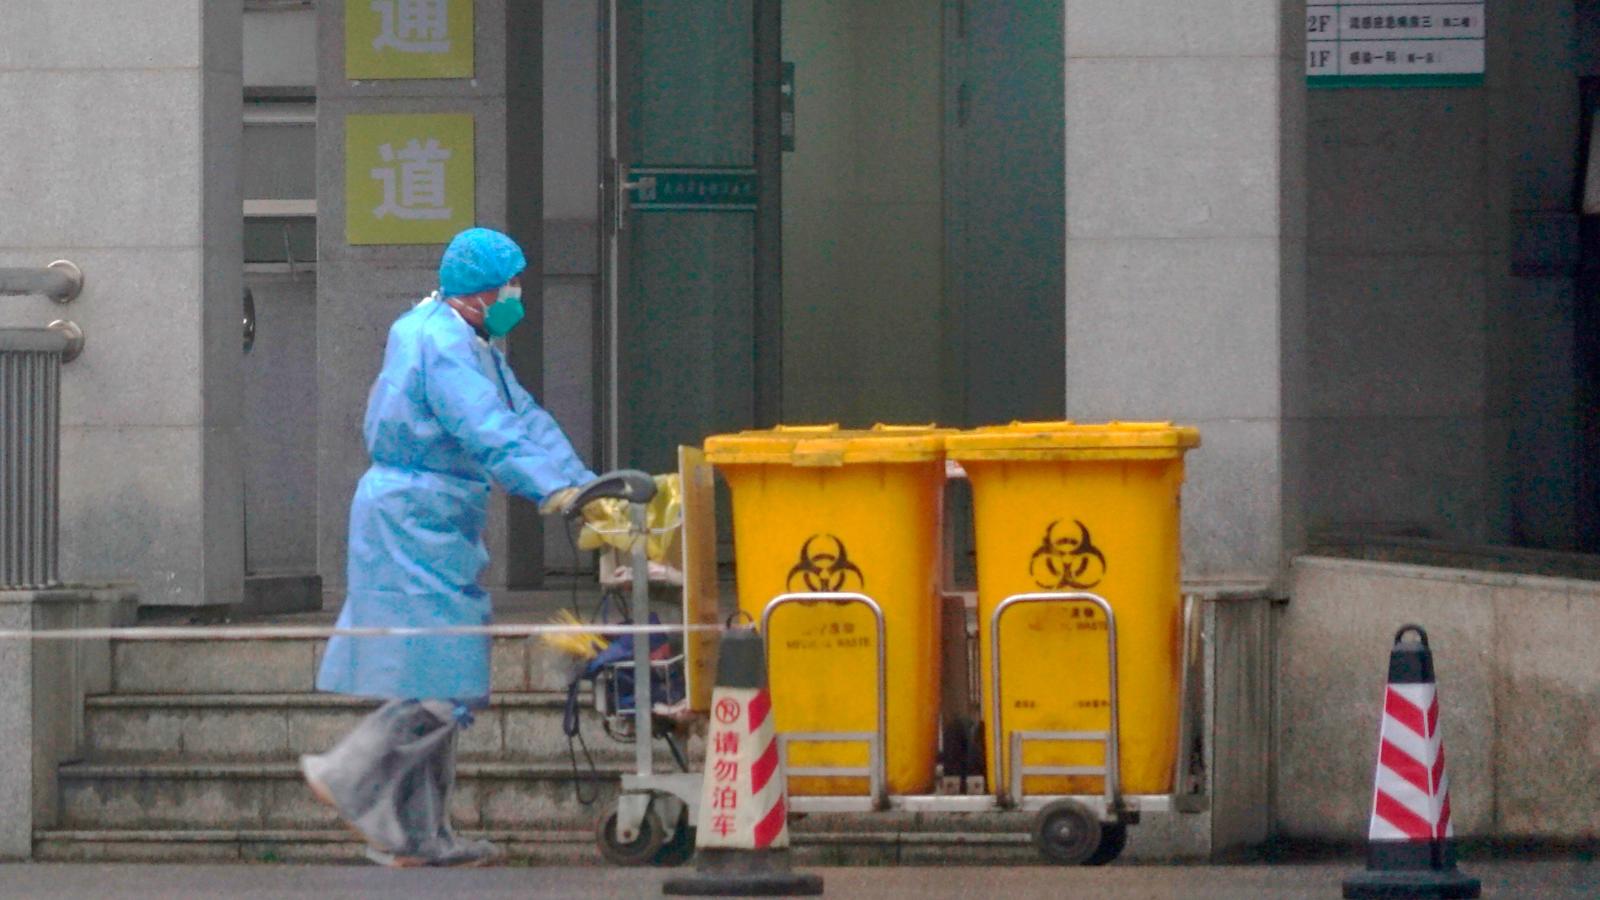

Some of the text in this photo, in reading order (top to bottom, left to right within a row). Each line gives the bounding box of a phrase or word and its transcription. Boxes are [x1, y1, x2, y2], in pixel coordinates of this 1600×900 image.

[1308, 15, 1331, 32] 2F
[1310, 50, 1330, 67] 1F
[837, 636, 870, 648] WASTE
[711, 730, 739, 837] 请勿泊车
